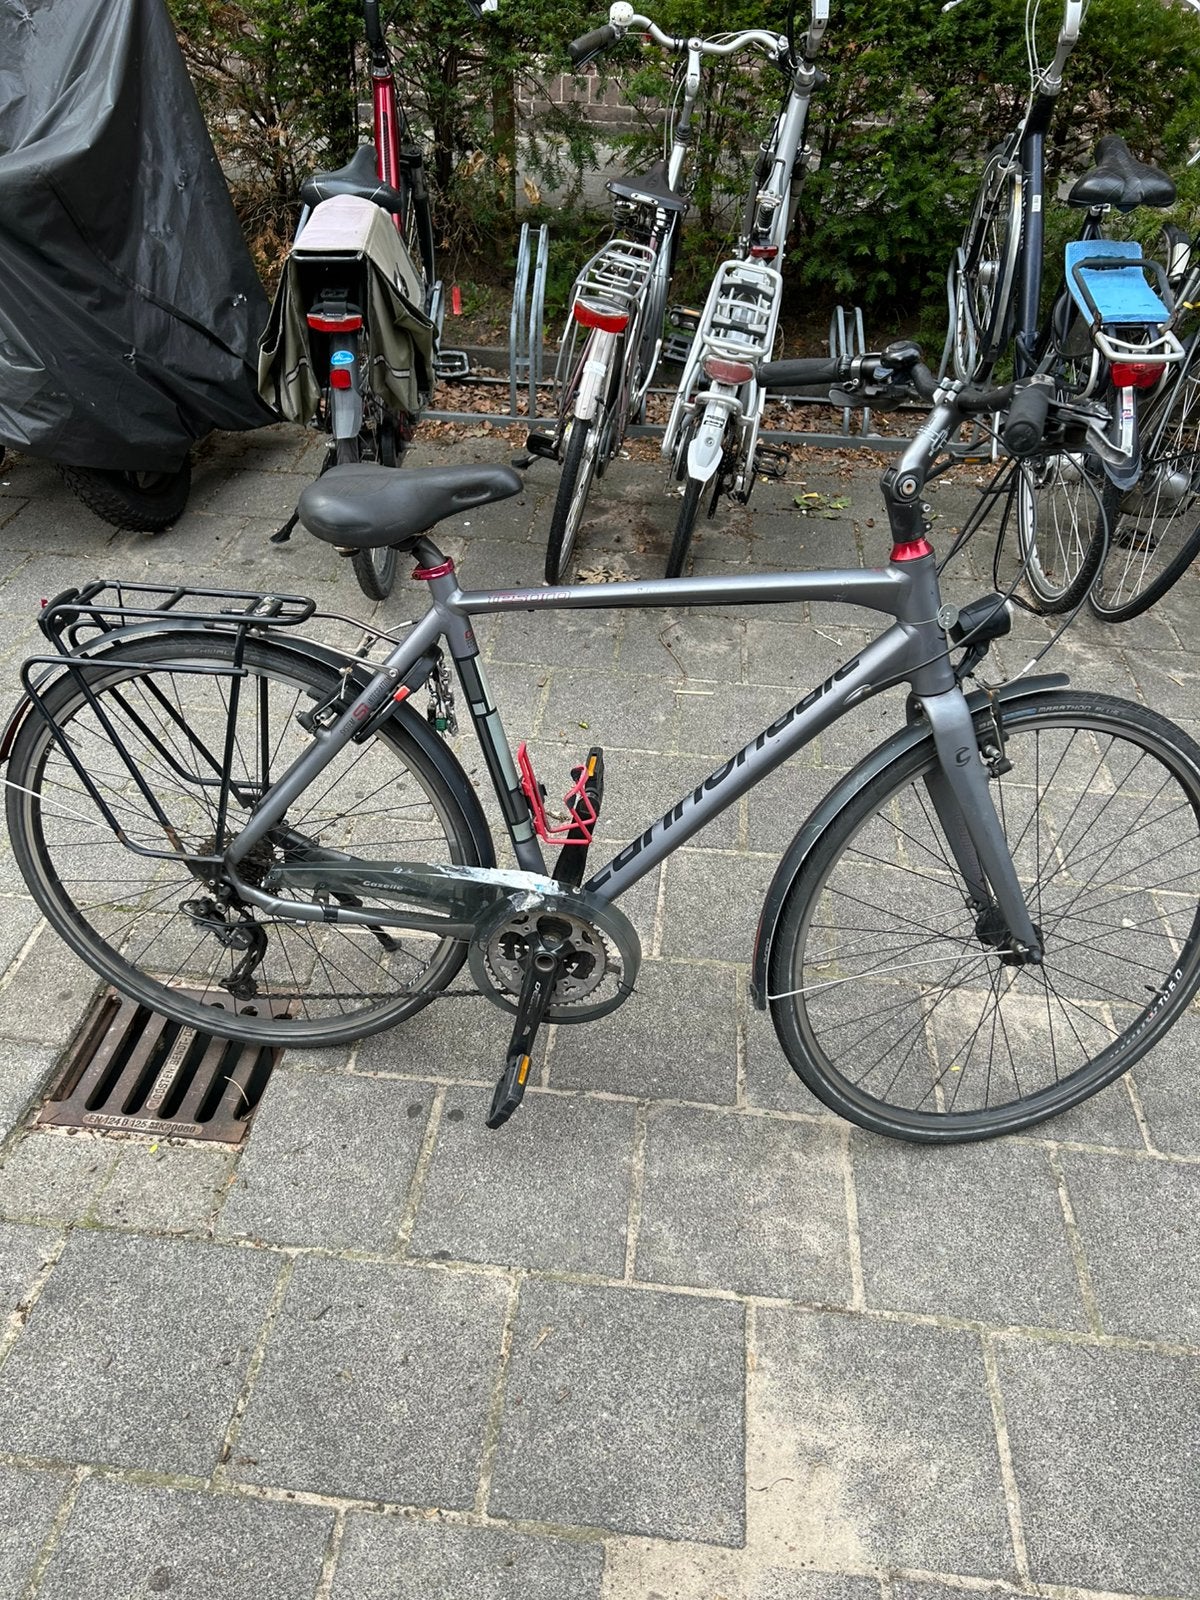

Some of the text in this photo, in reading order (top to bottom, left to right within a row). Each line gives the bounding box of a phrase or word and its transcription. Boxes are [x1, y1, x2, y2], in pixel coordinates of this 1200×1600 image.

[584, 659, 861, 893] cannondale
[362, 880, 404, 891] Gazelle
[131, 1119, 147, 1128] 125
